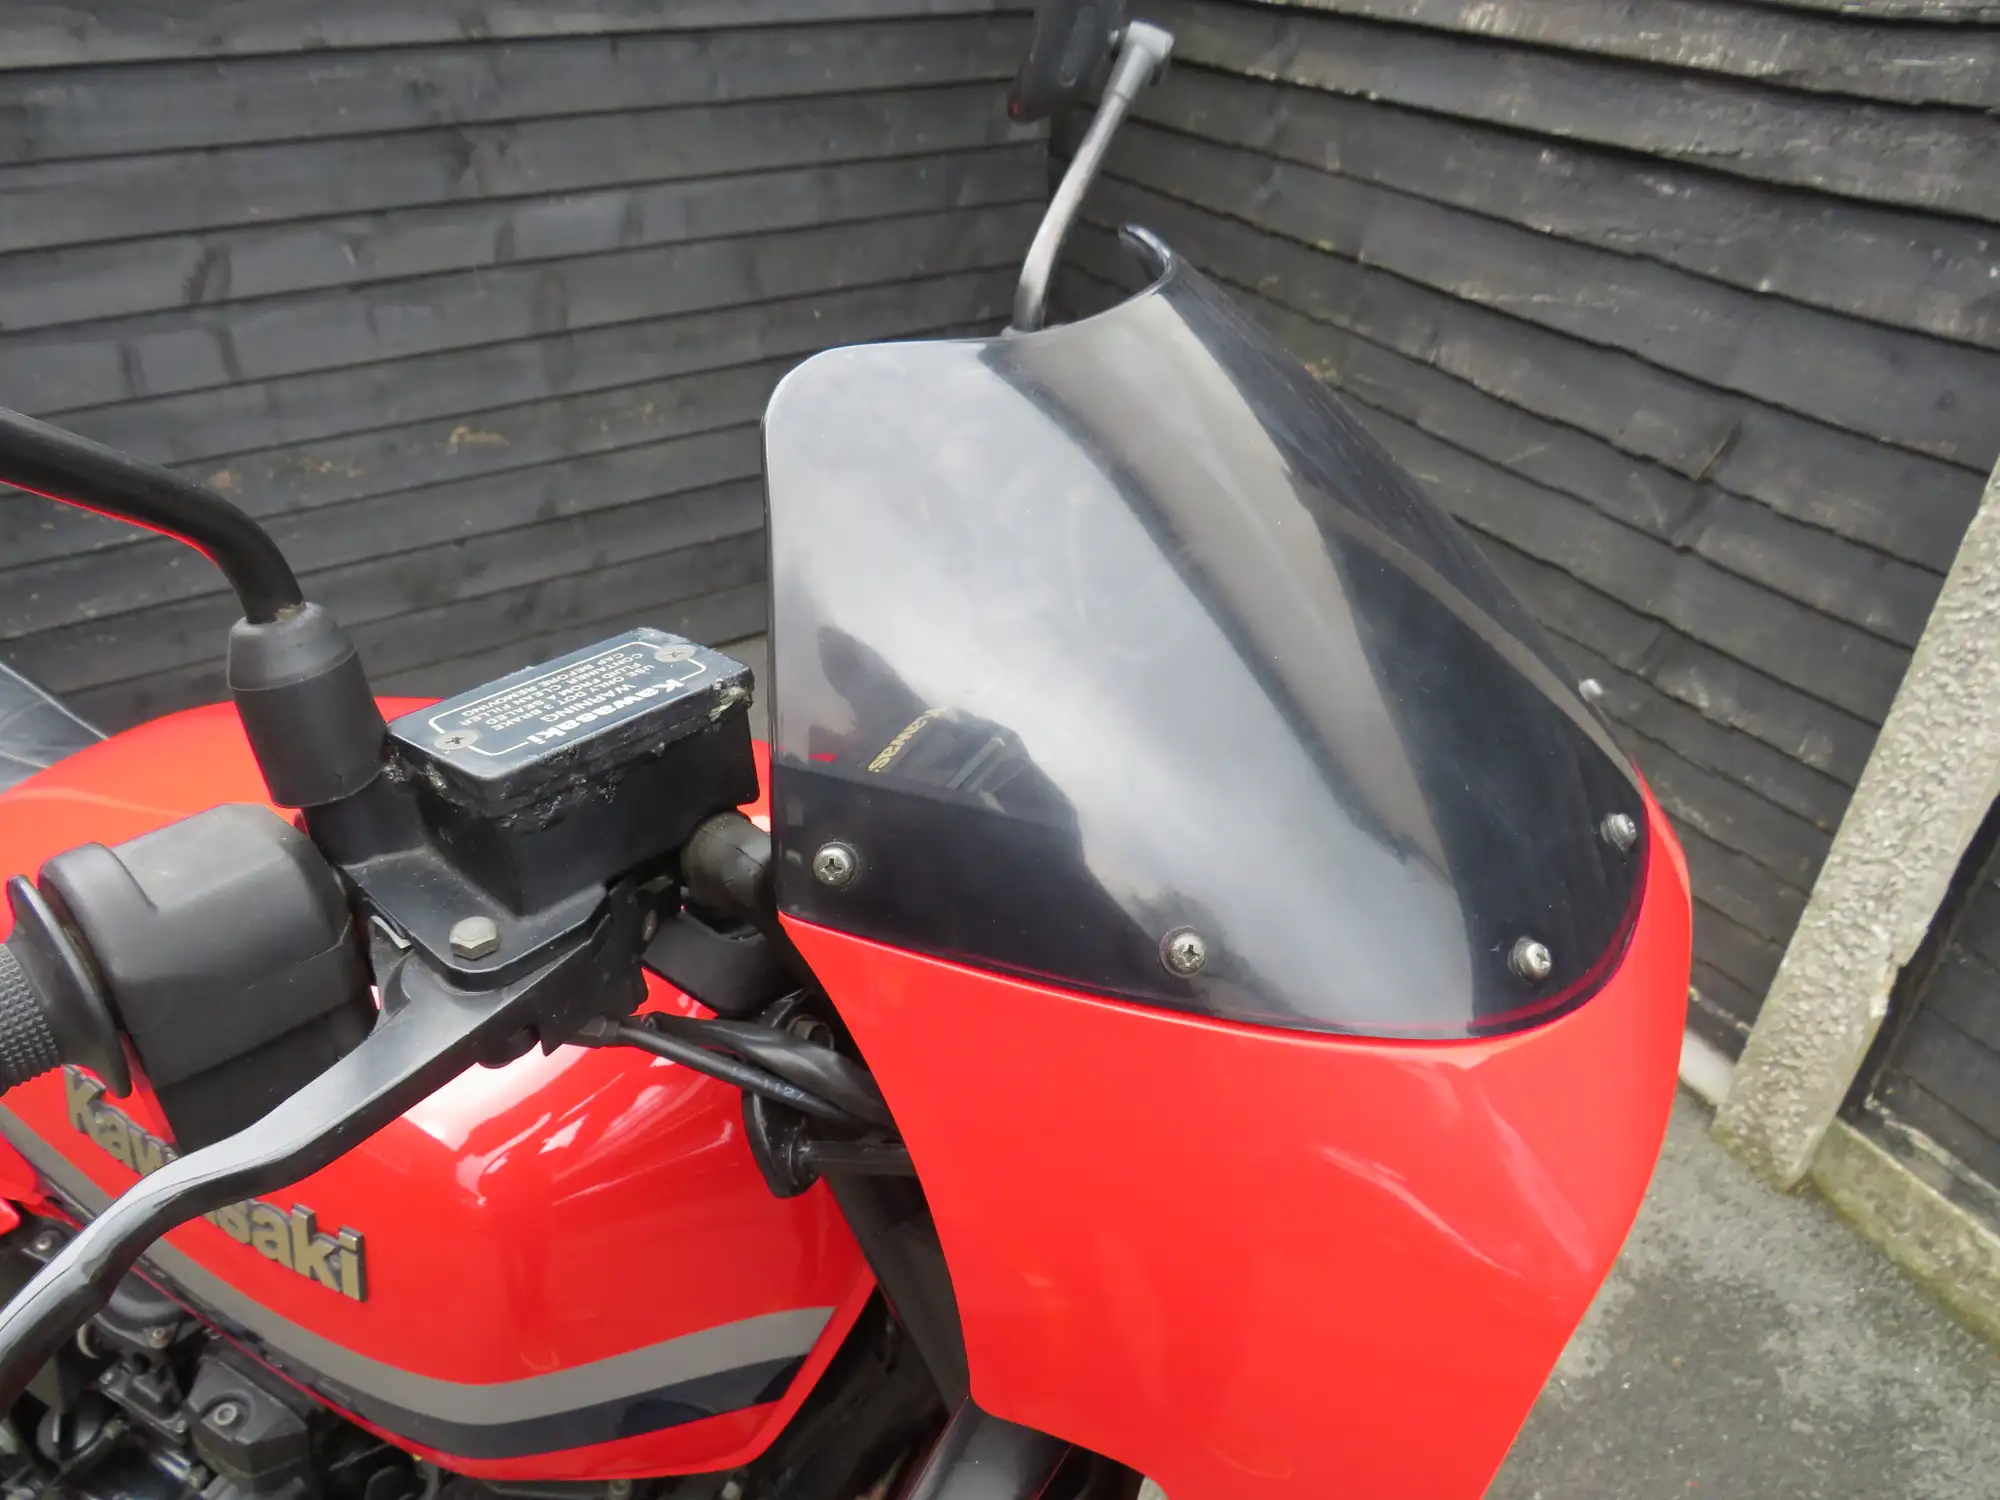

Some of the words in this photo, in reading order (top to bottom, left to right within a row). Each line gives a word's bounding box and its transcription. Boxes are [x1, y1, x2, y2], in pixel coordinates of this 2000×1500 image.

[597, 653, 624, 665] CAP
[538, 664, 594, 686] BEFORE
[602, 663, 641, 678] FLUID
[625, 665, 655, 677] USE
[513, 685, 561, 705] CLEAN
[558, 678, 600, 696] FROM
[590, 677, 624, 692] ONLY
[461, 687, 537, 716] REMOVING
[540, 684, 636, 722] WARNING
[558, 690, 588, 705] DOT
[460, 704, 512, 725] FILLER
[486, 700, 544, 724] SEALED
[491, 709, 542, 730] BRAKE
[526, 679, 685, 745] Kawasaki
[63, 1063, 368, 1303] Kawsaki
